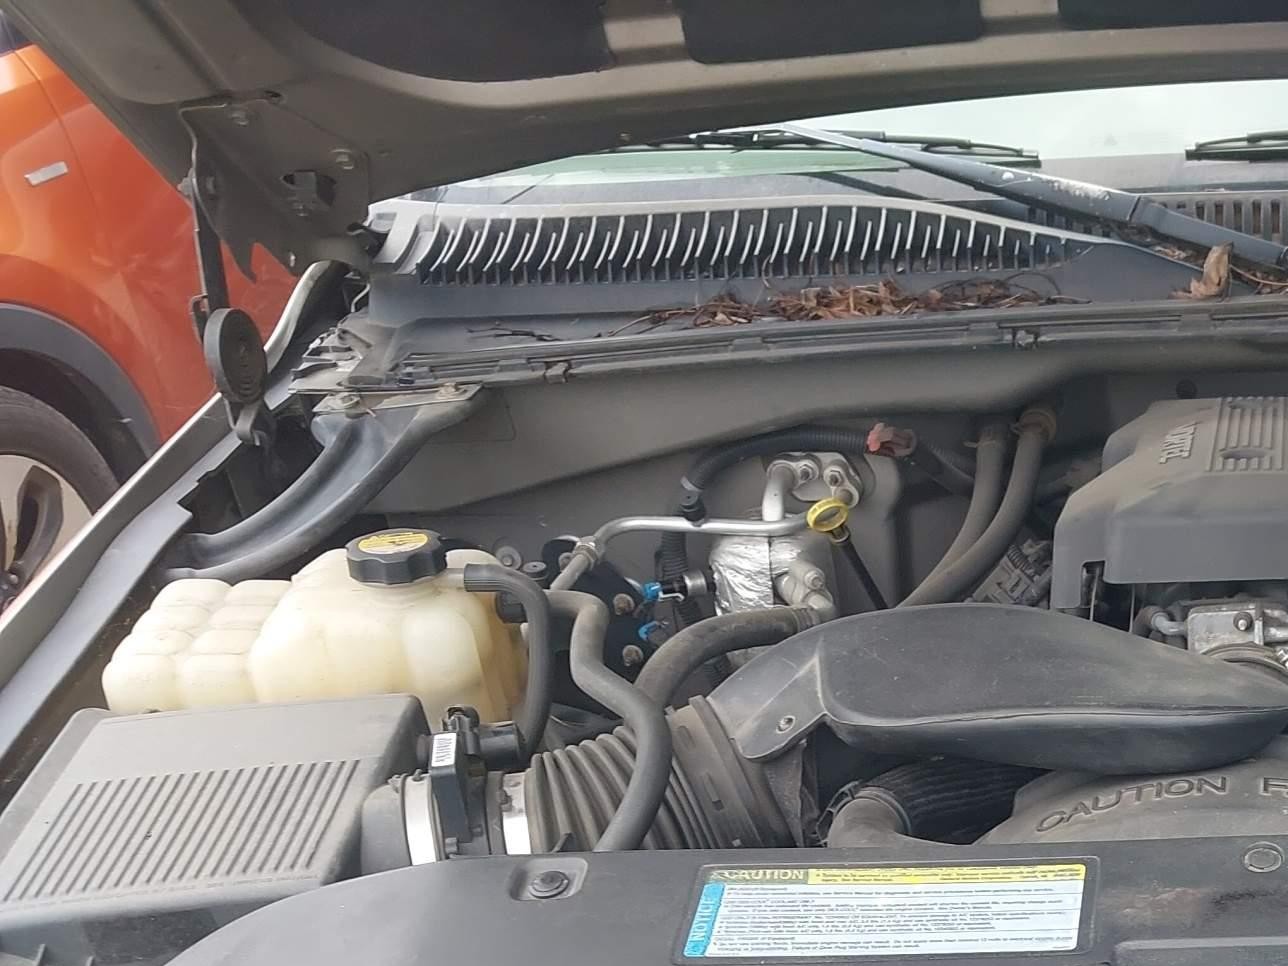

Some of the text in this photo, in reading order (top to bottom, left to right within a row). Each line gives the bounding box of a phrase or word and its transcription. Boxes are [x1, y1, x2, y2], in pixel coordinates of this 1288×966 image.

[1035, 774, 1229, 833] CAUTION
[725, 869, 804, 880] CAUTION
[688, 897, 715, 943] NOTICE
